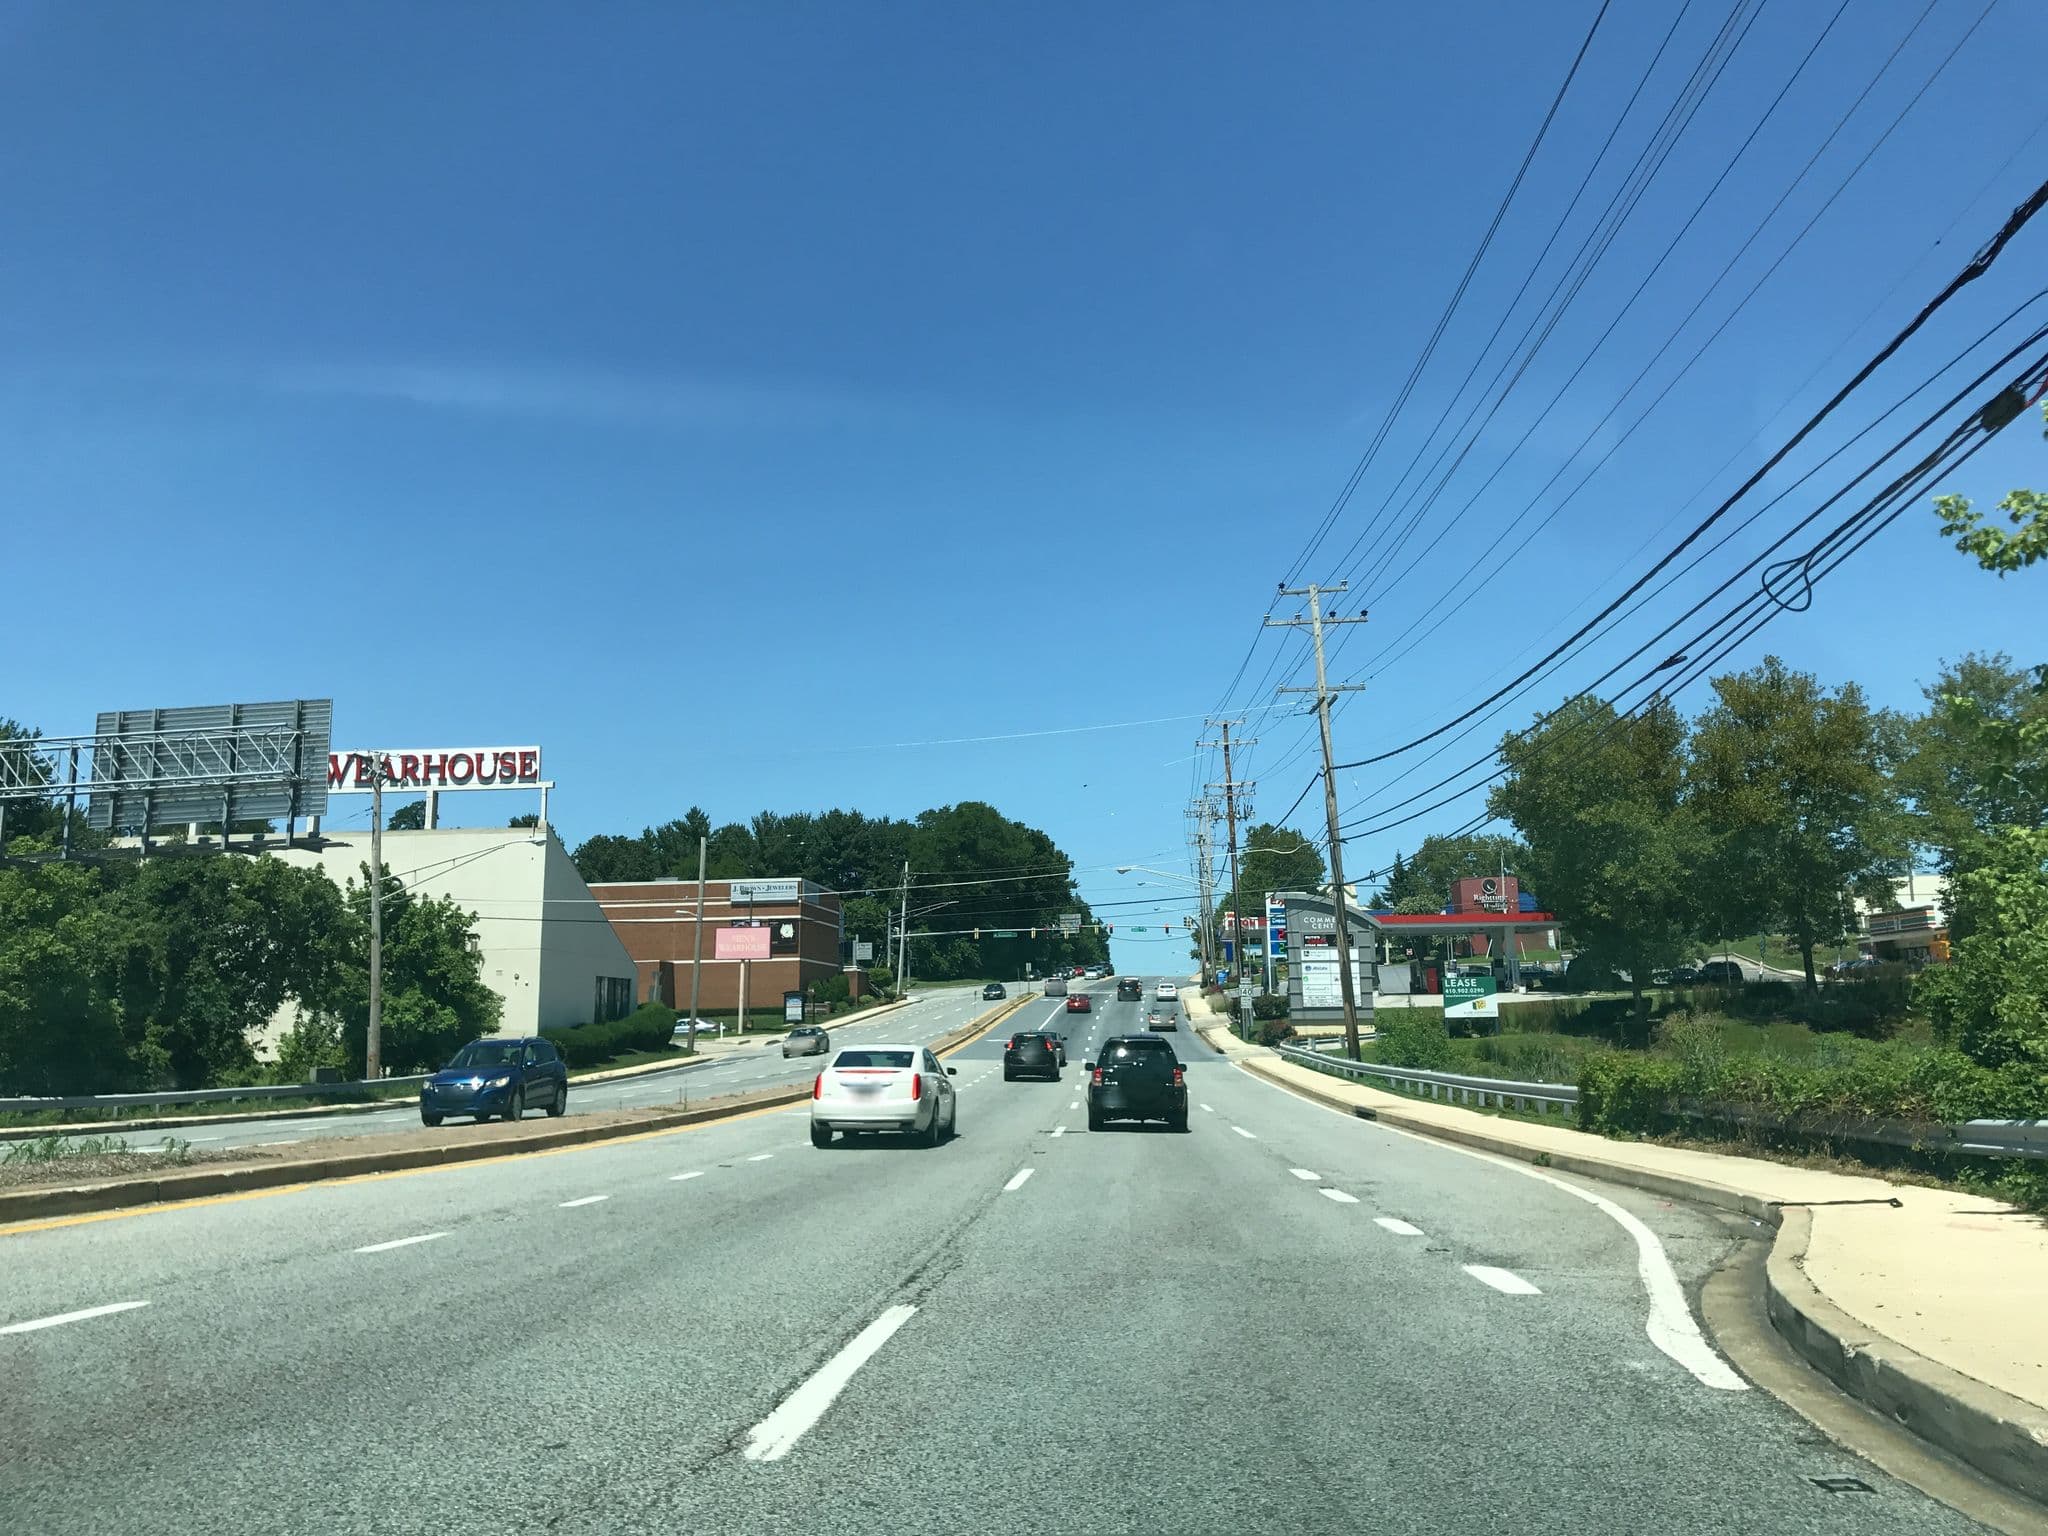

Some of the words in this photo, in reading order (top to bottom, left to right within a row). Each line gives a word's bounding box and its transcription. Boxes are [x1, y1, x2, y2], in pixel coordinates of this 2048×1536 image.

[328, 751, 538, 785] WEARHOUSE
[1303, 916, 1337, 924] COMME
[1444, 978, 1477, 988] LEASE
